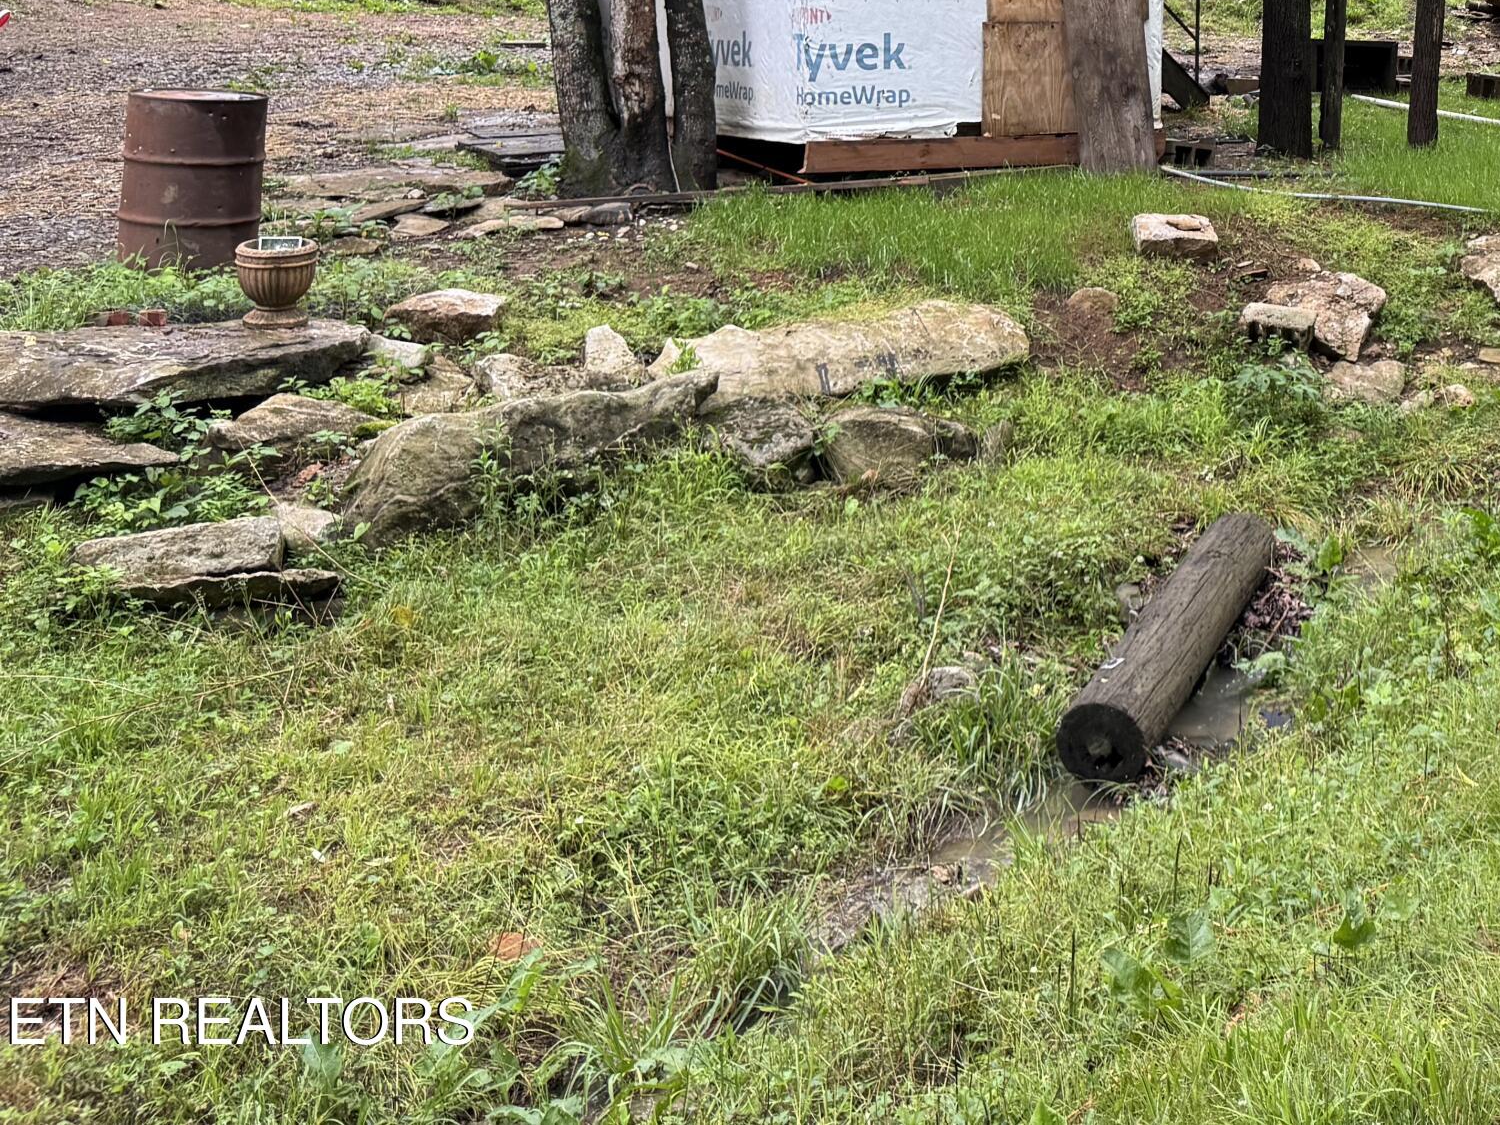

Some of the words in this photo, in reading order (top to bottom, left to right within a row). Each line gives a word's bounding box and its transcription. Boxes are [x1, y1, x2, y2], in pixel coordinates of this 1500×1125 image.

[709, 30, 753, 68] yvek
[793, 32, 906, 82] Tyvek
[716, 81, 754, 105] meWrap
[796, 85, 911, 108] HomeWrap
